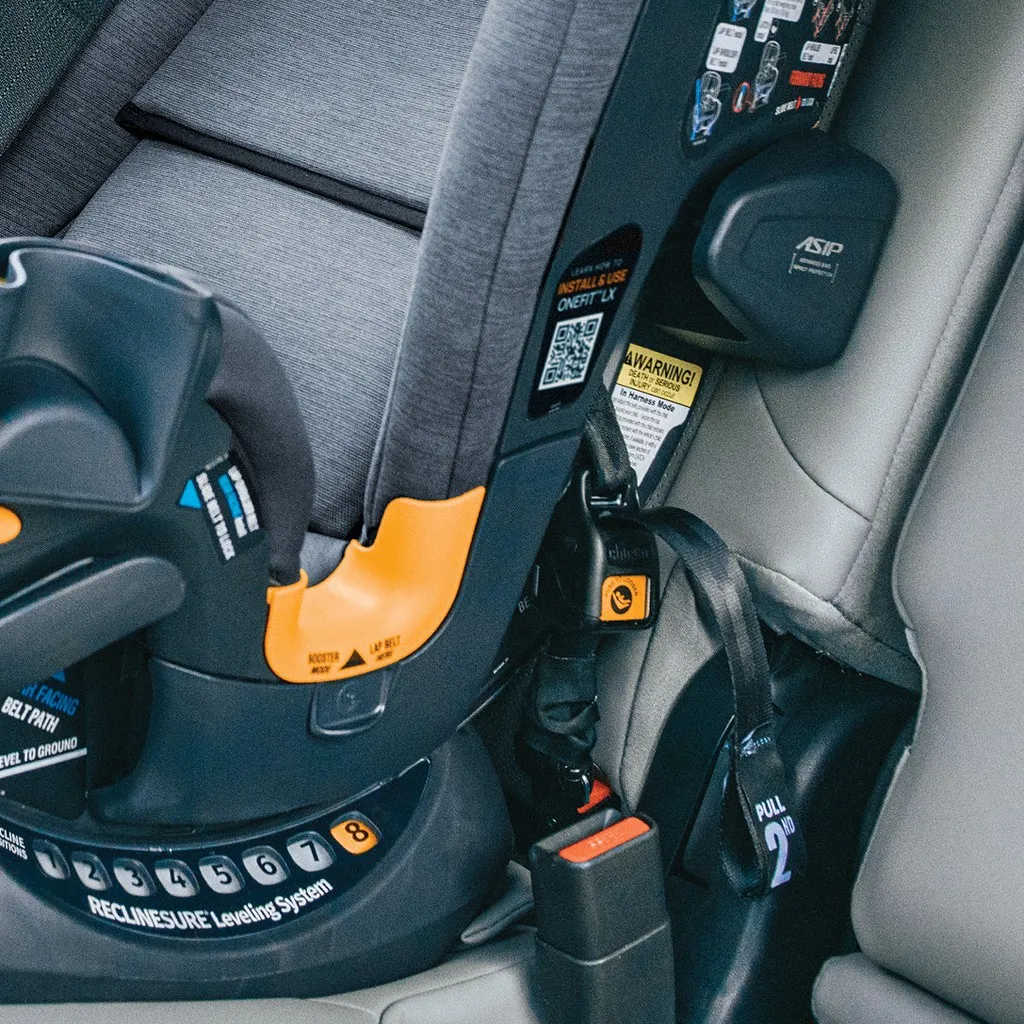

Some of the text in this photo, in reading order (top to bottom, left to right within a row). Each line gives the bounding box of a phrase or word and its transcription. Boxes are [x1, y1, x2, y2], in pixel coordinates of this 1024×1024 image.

[796, 236, 844, 257] ASIP
[628, 368, 648, 384] DEATH
[655, 377, 681, 393] SERIOUS
[633, 353, 697, 387] WARNING!
[629, 377, 651, 391] INJURY
[620, 388, 676, 413] In Harness Mode
[1, 696, 60, 734] BELT PATH
[23, 747, 37, 762] TO
[37, 736, 78, 759] GROUND
[754, 795, 787, 823] PULL
[87, 859, 102, 883] 2
[123, 865, 144, 888] 3
[168, 867, 187, 888] 4
[211, 863, 233, 885] 5
[255, 854, 278, 876] 6
[299, 840, 320, 863] 7
[344, 821, 370, 843] 8
[210, 901, 283, 929] Leveling
[274, 878, 334, 915] System
